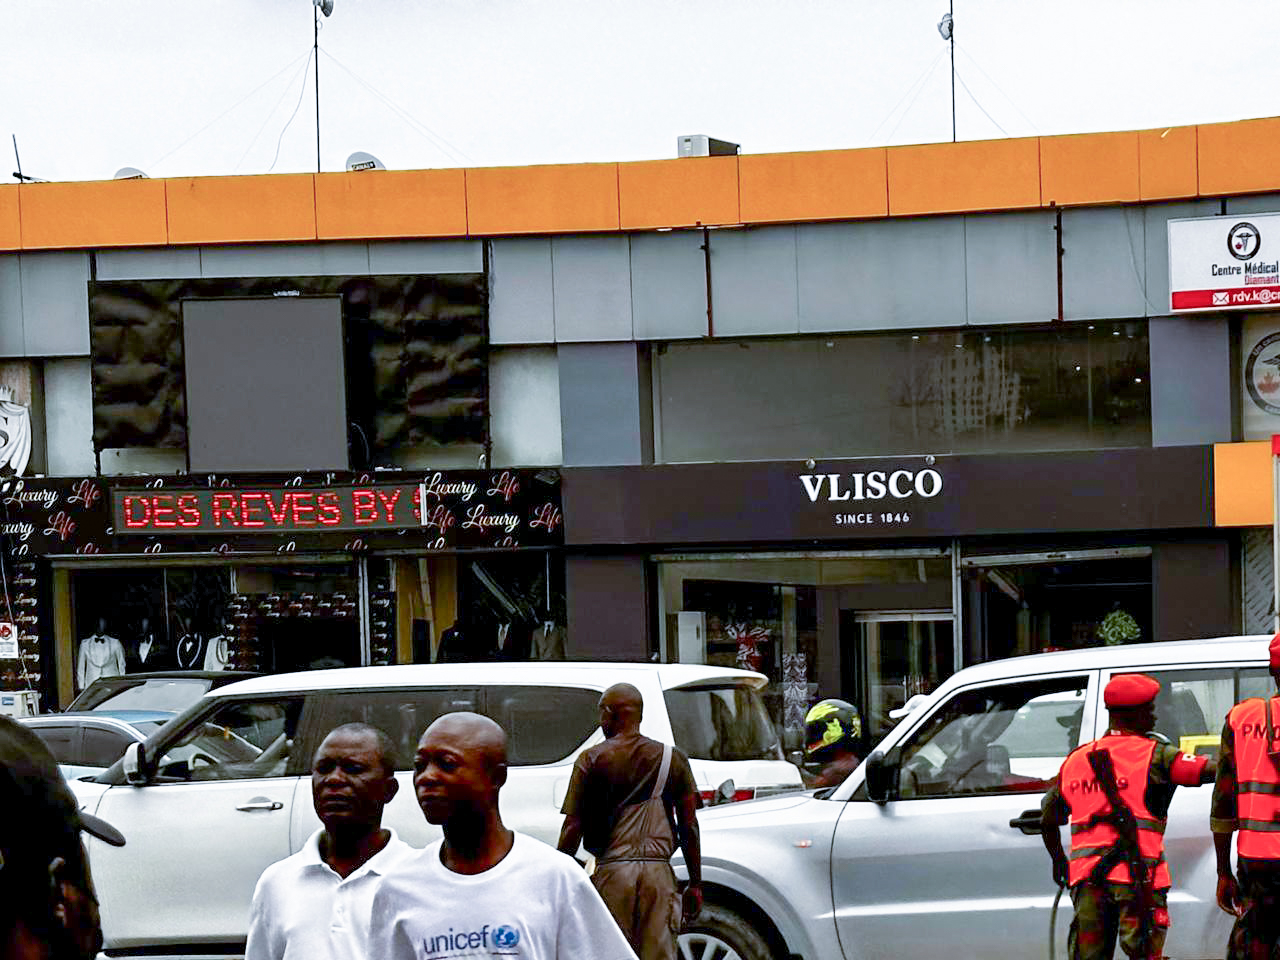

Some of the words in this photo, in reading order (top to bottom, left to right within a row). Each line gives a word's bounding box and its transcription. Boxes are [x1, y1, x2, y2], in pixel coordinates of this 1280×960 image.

[1212, 264, 1242, 277] Centre
[1244, 261, 1279, 274] Médical
[1244, 274, 1279, 285] Diamant
[4, 481, 58, 508] Luxury
[67, 479, 101, 509] Life
[425, 472, 478, 500] Luxury
[487, 472, 520, 501] Life
[799, 469, 943, 502] VLISCO
[124, 494, 201, 527] DES
[212, 492, 341, 526] REVES
[352, 489, 400, 524] BY
[461, 503, 520, 533] Luxury
[529, 503, 562, 533] Life
[835, 513, 873, 524] SINCE
[881, 512, 910, 523] 1846
[43, 511, 76, 541] Life
[423, 925, 491, 954] unicef
